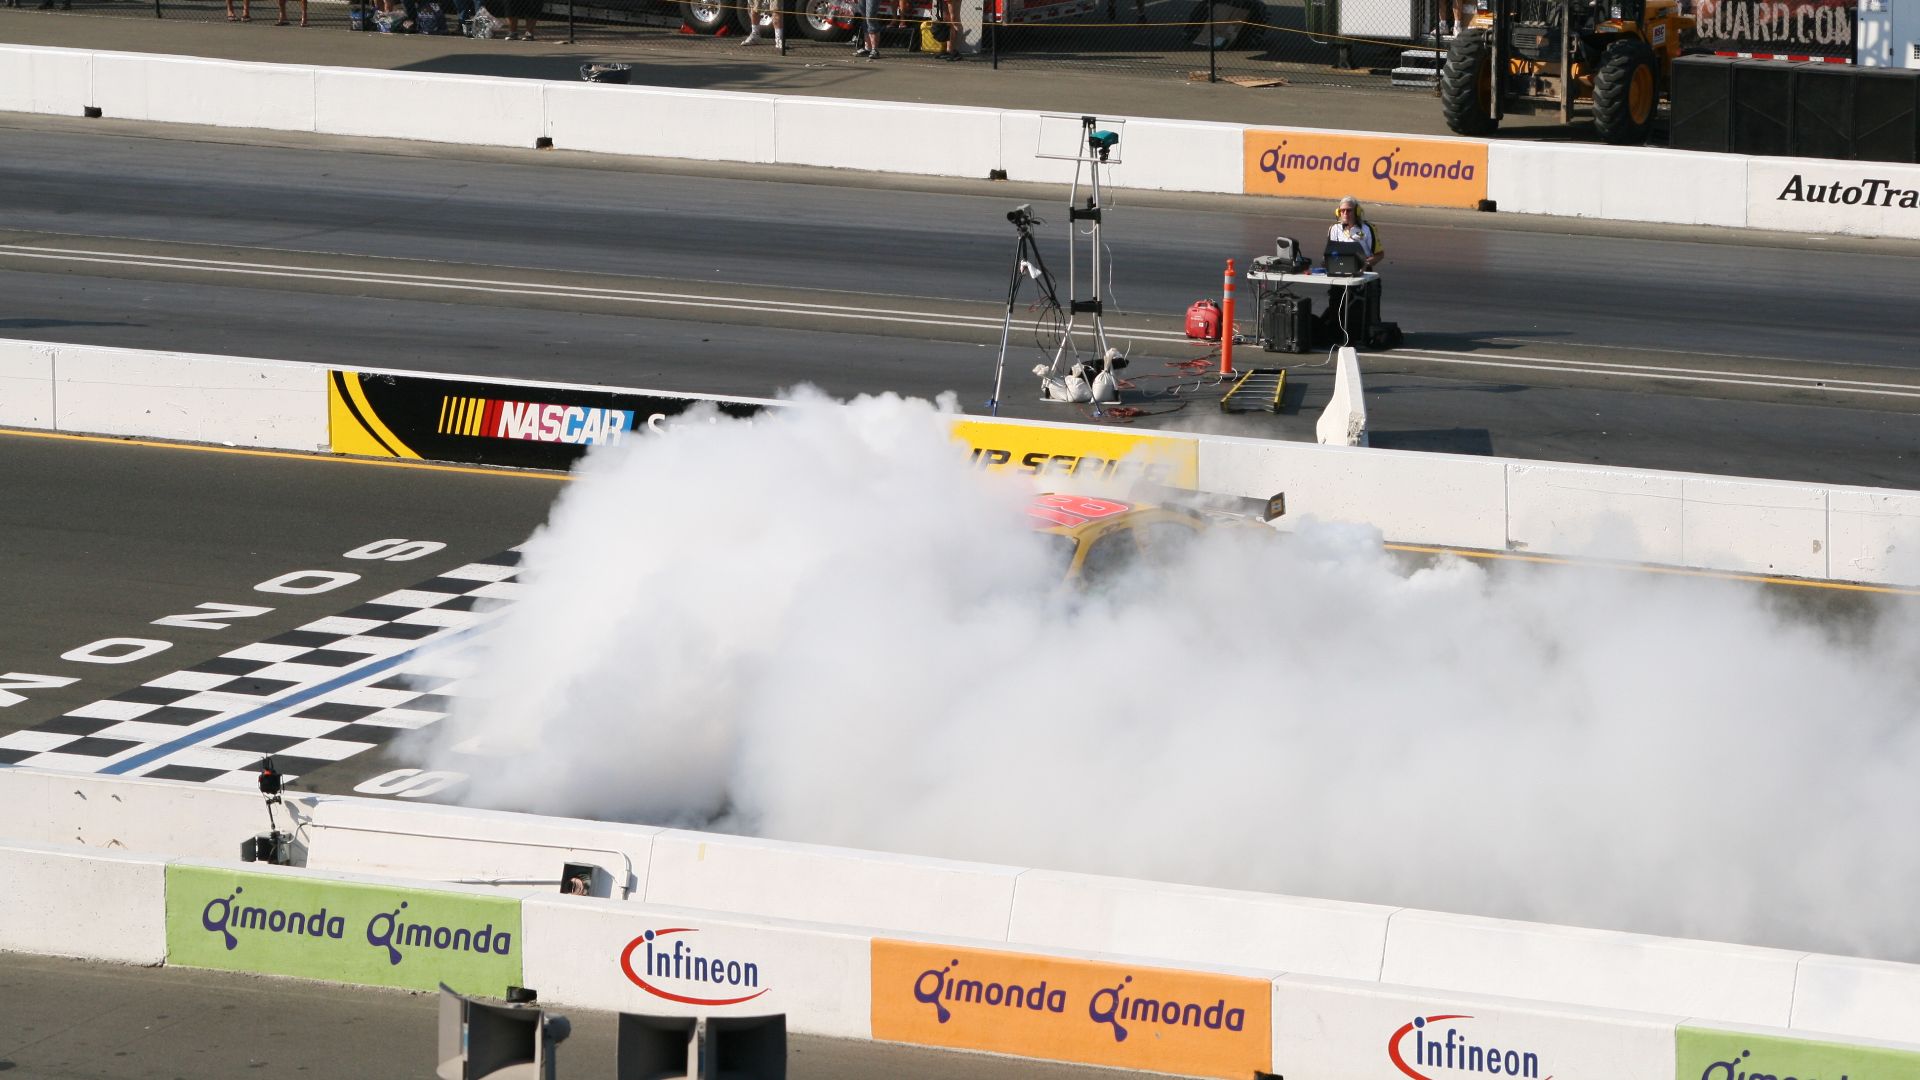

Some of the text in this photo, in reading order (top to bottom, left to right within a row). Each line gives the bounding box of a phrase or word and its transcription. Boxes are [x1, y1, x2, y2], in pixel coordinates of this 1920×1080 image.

[1260, 140, 1475, 190] Qimonda Qimonda
[498, 401, 625, 446] NASCAR
[202, 886, 512, 965] Qimonda Qimonda
[914, 959, 1245, 1042] Qimonda Qimonda
